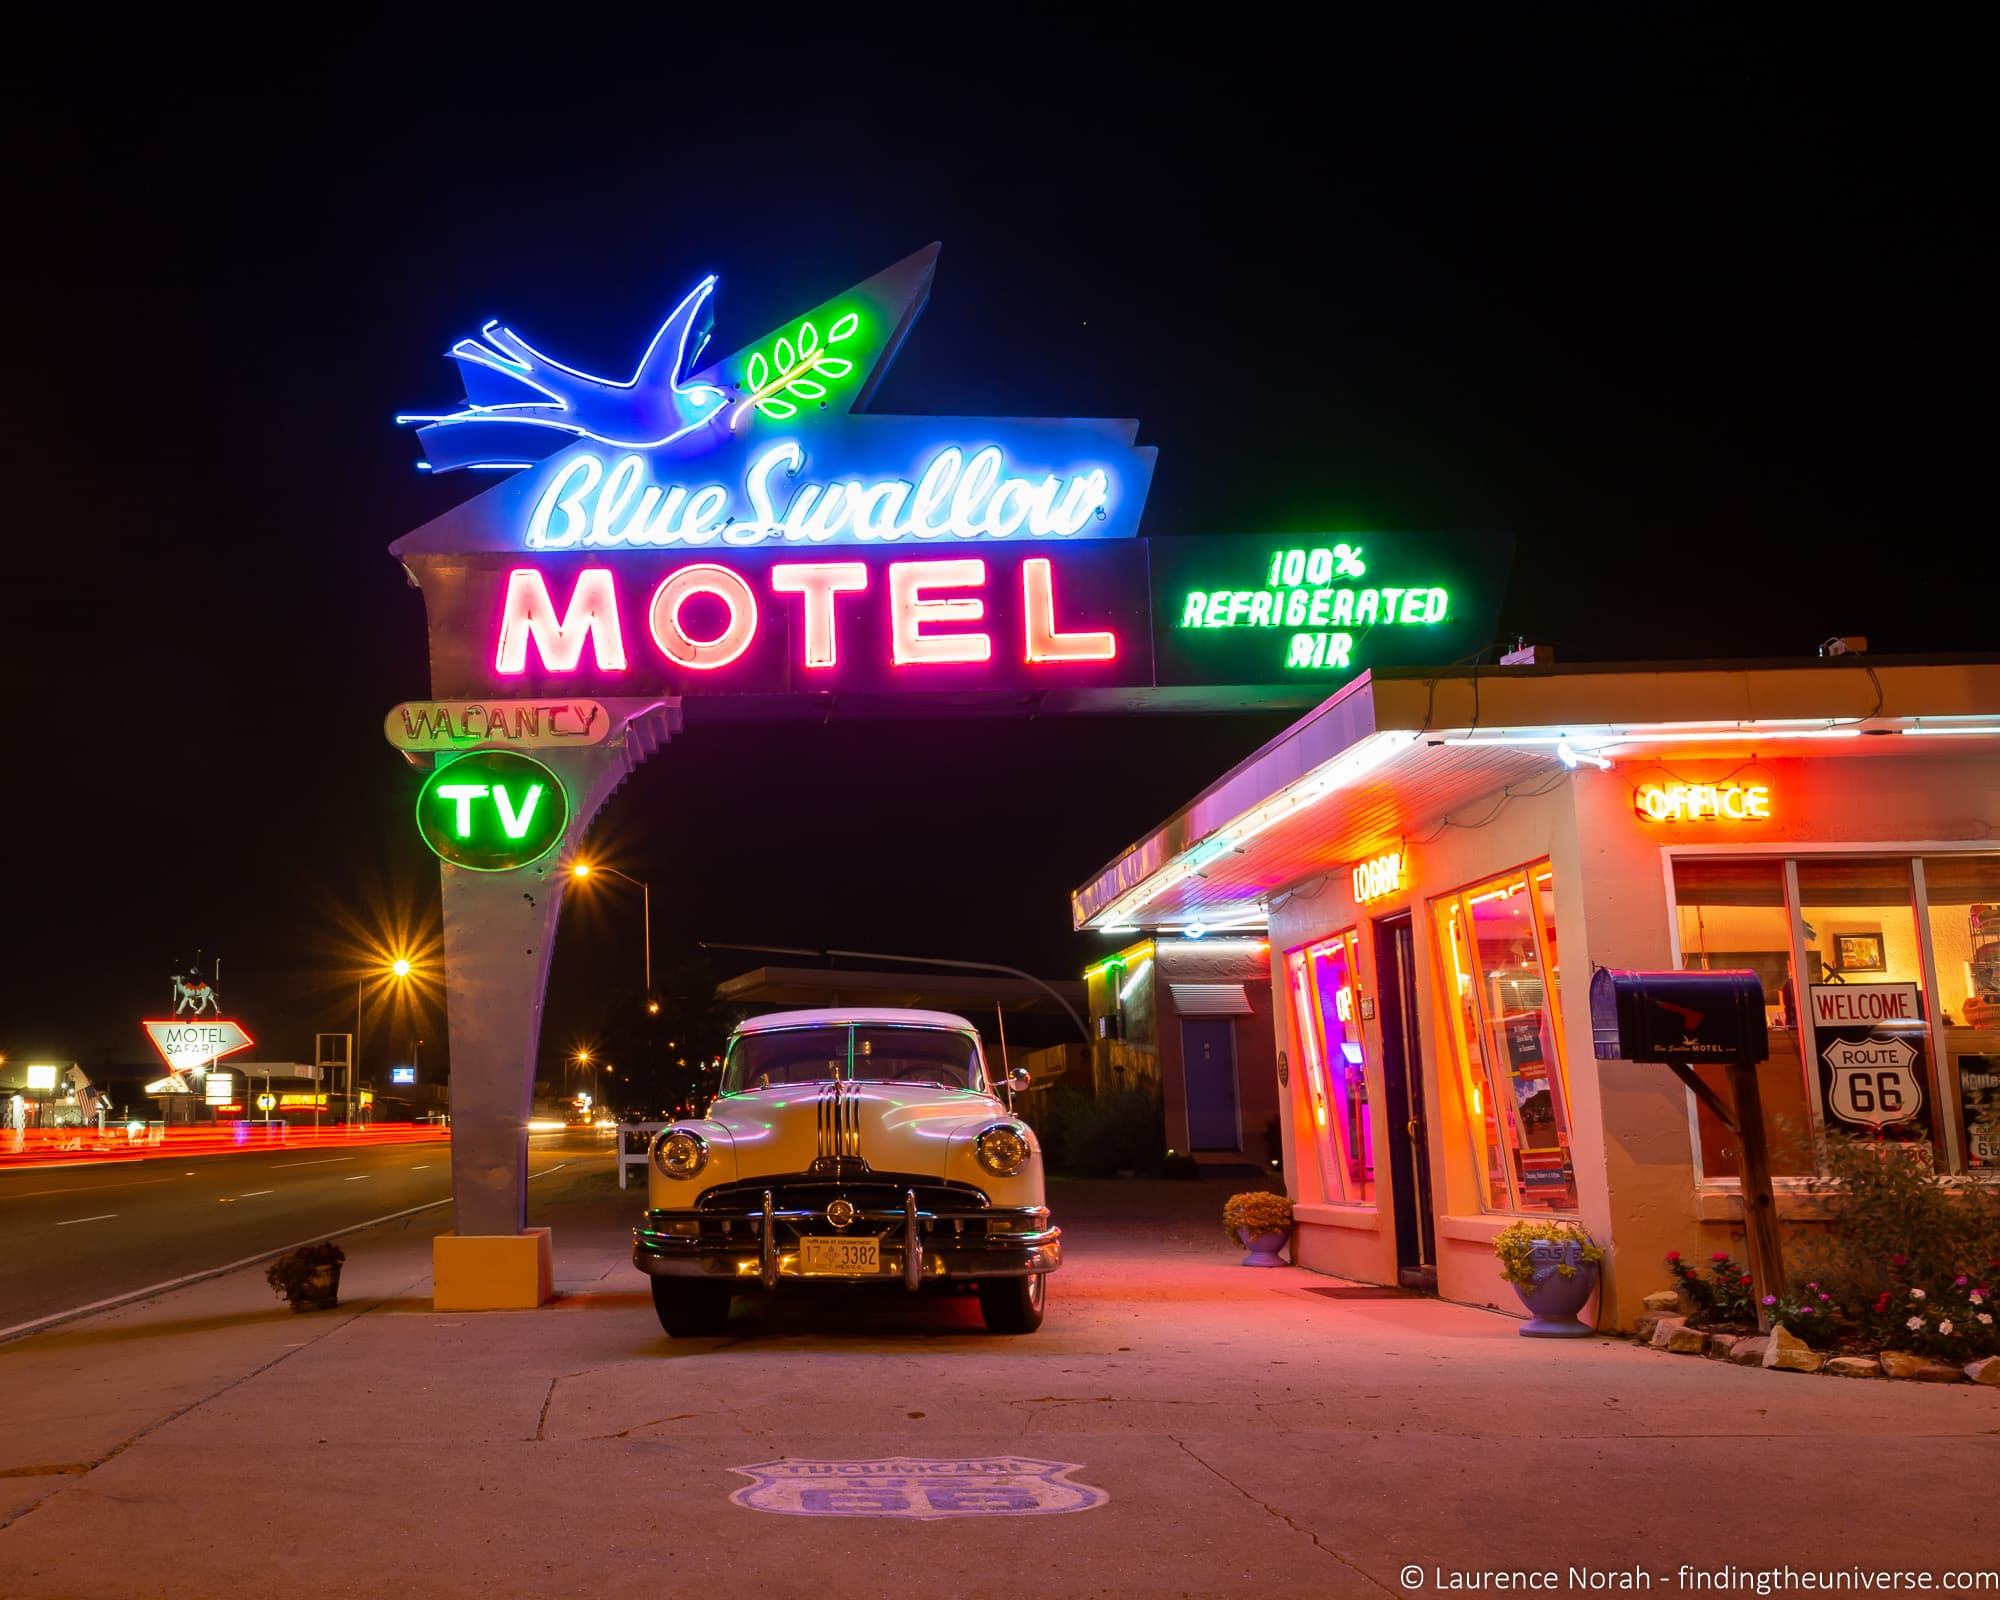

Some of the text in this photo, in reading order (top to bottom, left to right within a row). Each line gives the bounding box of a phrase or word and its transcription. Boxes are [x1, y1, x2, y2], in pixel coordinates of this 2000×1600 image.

[525, 443, 1107, 548] Blue Swallow
[1268, 543, 1366, 587] 100%
[495, 558, 1116, 672] MOTEL
[1181, 588, 1449, 628] REFRIGERATED
[1286, 632, 1353, 668] AIR
[401, 704, 598, 740] VACANCY
[436, 784, 544, 839] TV
[1643, 785, 1771, 820] OFFICE
[1352, 852, 1400, 904] LOBBY
[1816, 992, 1912, 1021] WELCOME
[166, 1028, 227, 1043] MOTEL
[166, 1044, 215, 1055] SAFARI
[1692, 1044, 1722, 1052] MOTEL
[1843, 1050, 1899, 1065] ROUTE
[1849, 1072, 1903, 1113] 66
[841, 1246, 876, 1265] 3382
[787, 1463, 1022, 1474] TUCUMCARI
[800, 1488, 1040, 1511] 66
